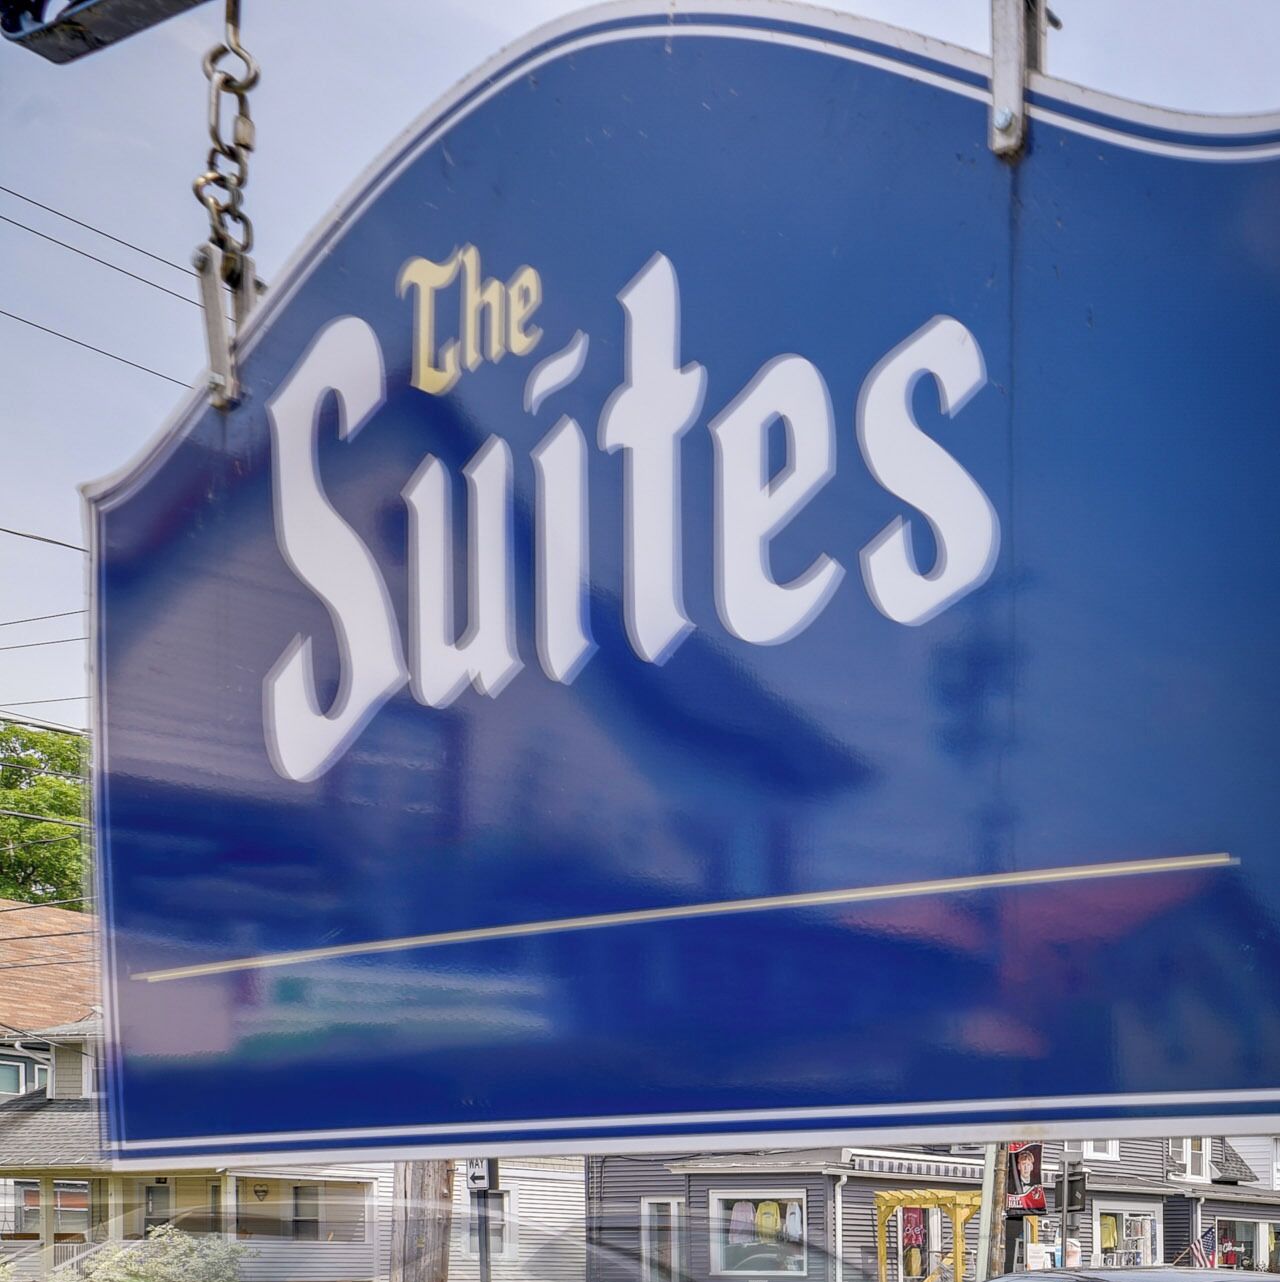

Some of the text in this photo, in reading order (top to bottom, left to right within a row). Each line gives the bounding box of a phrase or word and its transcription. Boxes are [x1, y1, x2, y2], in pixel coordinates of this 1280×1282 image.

[395, 242, 544, 396] The
[263, 252, 1000, 782] Suites
[470, 1158, 484, 1169] WAY
